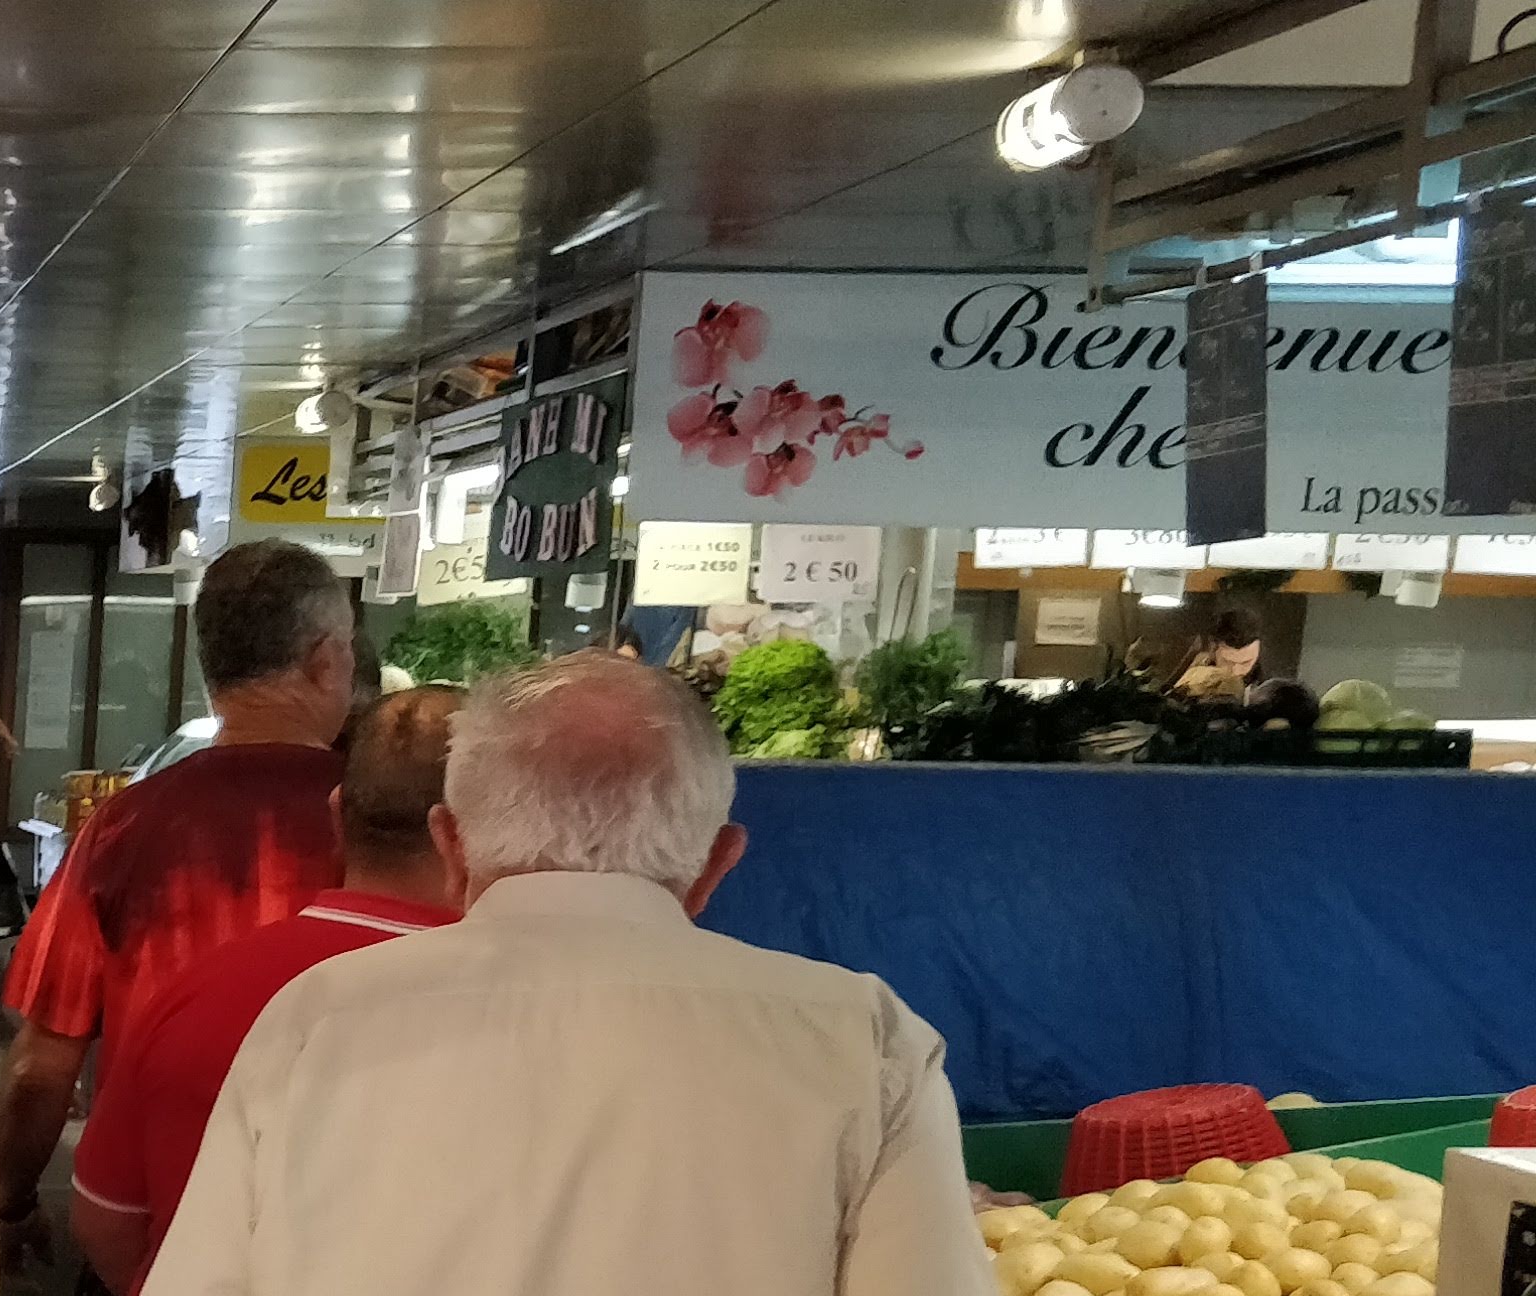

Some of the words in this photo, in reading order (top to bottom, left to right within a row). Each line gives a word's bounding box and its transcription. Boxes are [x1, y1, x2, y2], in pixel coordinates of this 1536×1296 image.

[930, 282, 1452, 373] Biennue
[1045, 385, 1188, 469] che
[250, 456, 327, 505] Les
[1300, 476, 1342, 514] La
[500, 496, 532, 562] BO
[537, 487, 598, 562] BUN
[435, 554, 486, 587] 2€5
[783, 561, 797, 582] 2
[806, 561, 822, 583] €
[828, 560, 858, 583] 50
